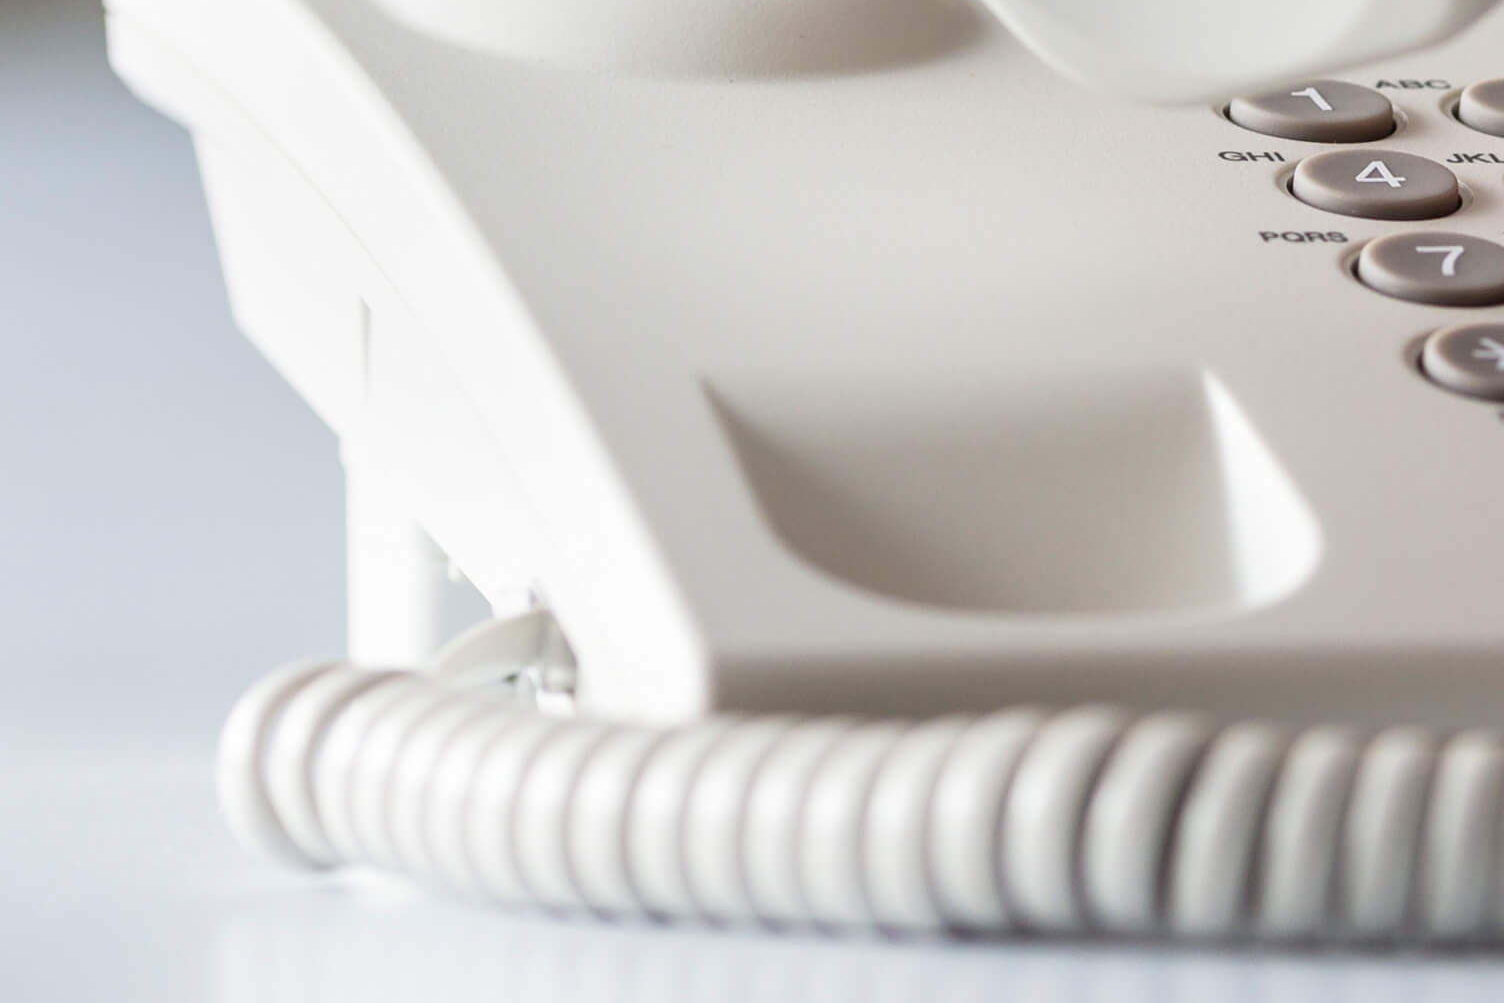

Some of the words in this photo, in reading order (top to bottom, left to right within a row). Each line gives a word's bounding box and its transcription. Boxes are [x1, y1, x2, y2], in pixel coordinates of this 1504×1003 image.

[1375, 79, 1452, 91] ABC
[1291, 86, 1333, 111] 1
[1218, 150, 1284, 162] GHI
[1354, 160, 1406, 188] 4
[1258, 231, 1349, 243] PQRS
[1416, 245, 1464, 276] 7
